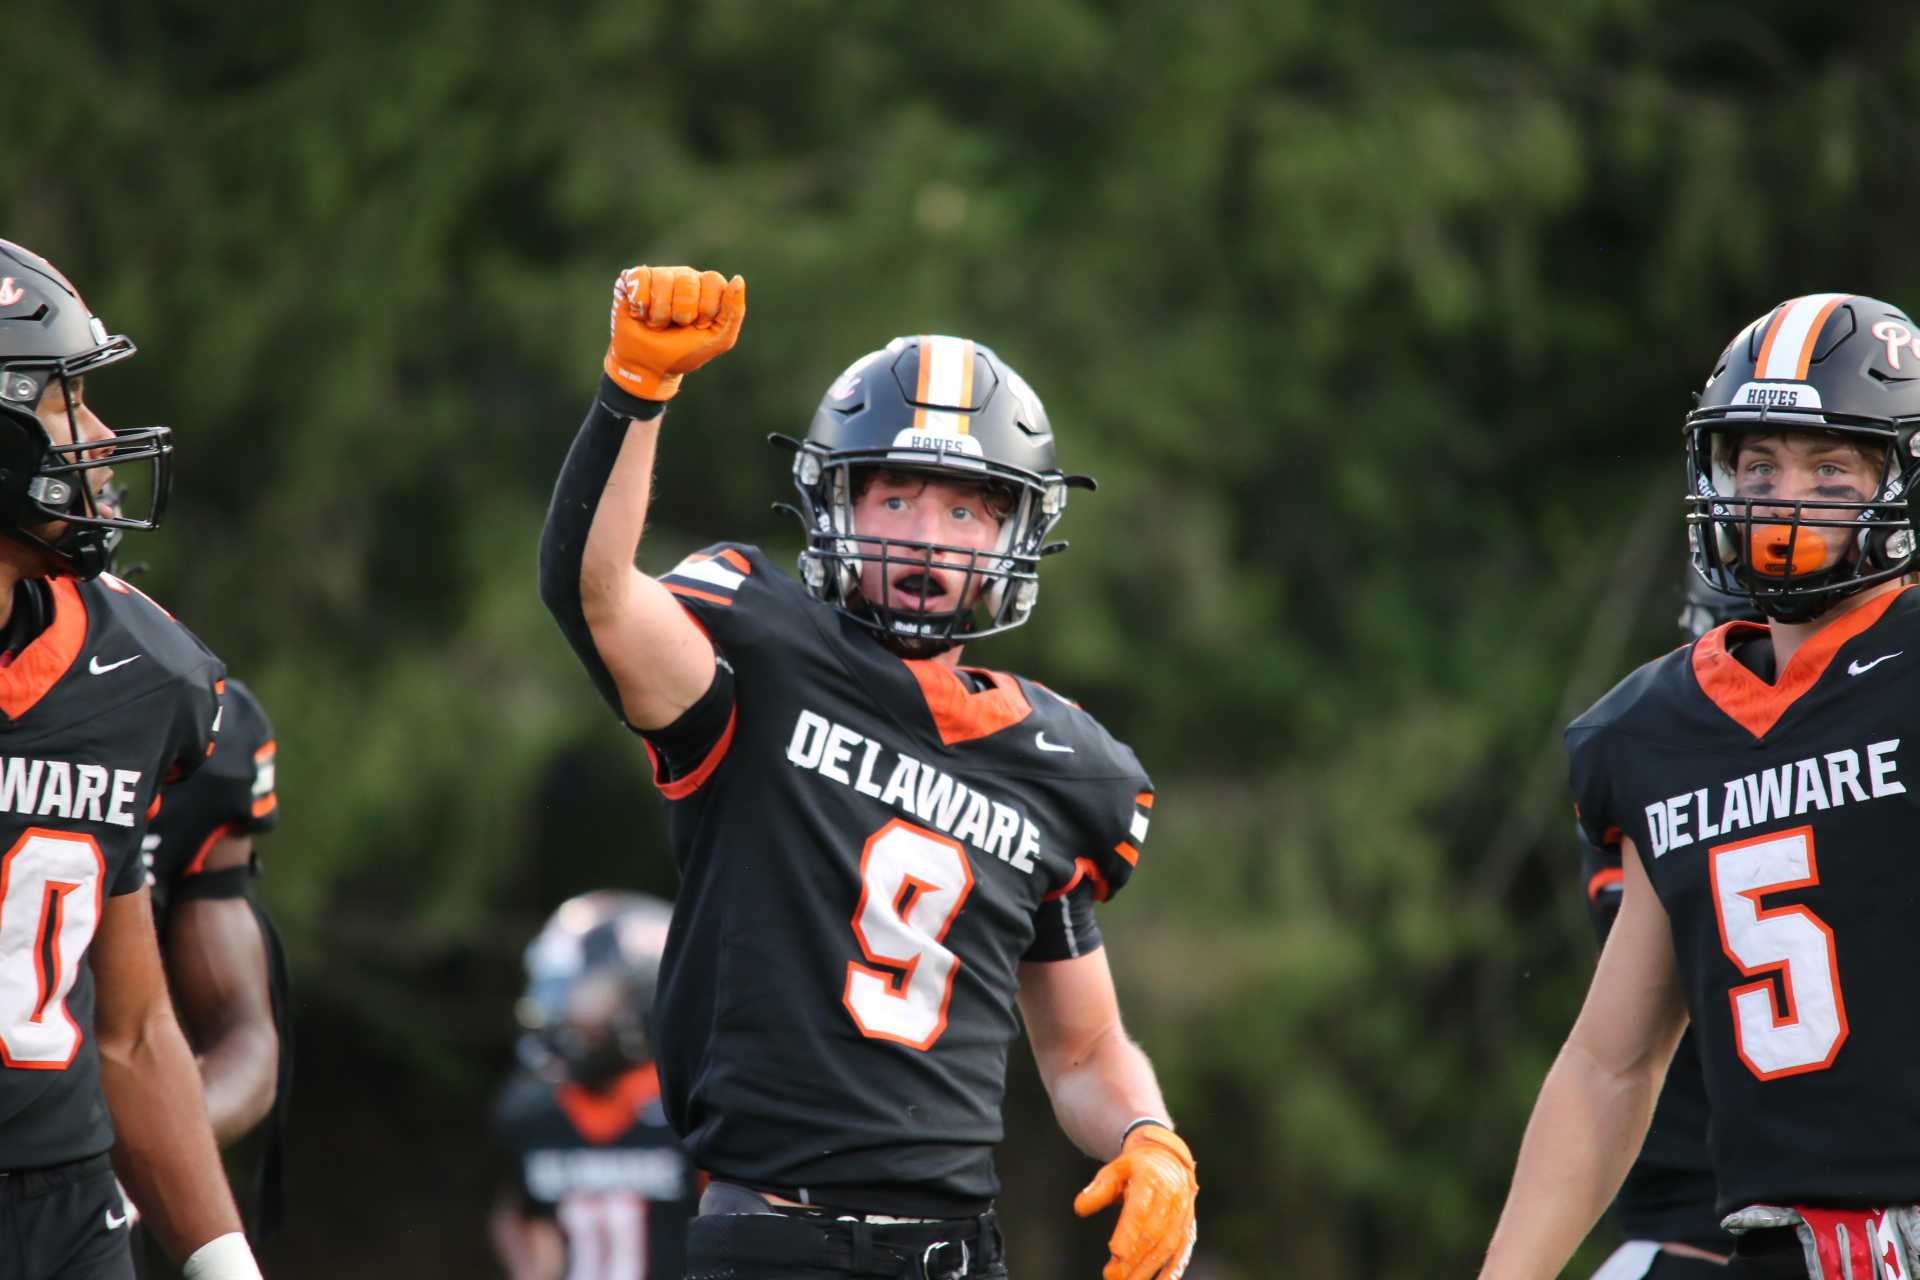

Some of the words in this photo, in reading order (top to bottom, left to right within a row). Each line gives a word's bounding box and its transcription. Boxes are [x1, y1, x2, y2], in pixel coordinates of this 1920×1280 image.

[1746, 389, 1798, 407] HAYES
[787, 709, 1041, 874] DELAWARE
[1645, 739, 1907, 859] DELAWARE
[0, 826, 106, 1071] 0
[843, 817, 974, 1051] 9
[1709, 825, 1849, 1082] 5
